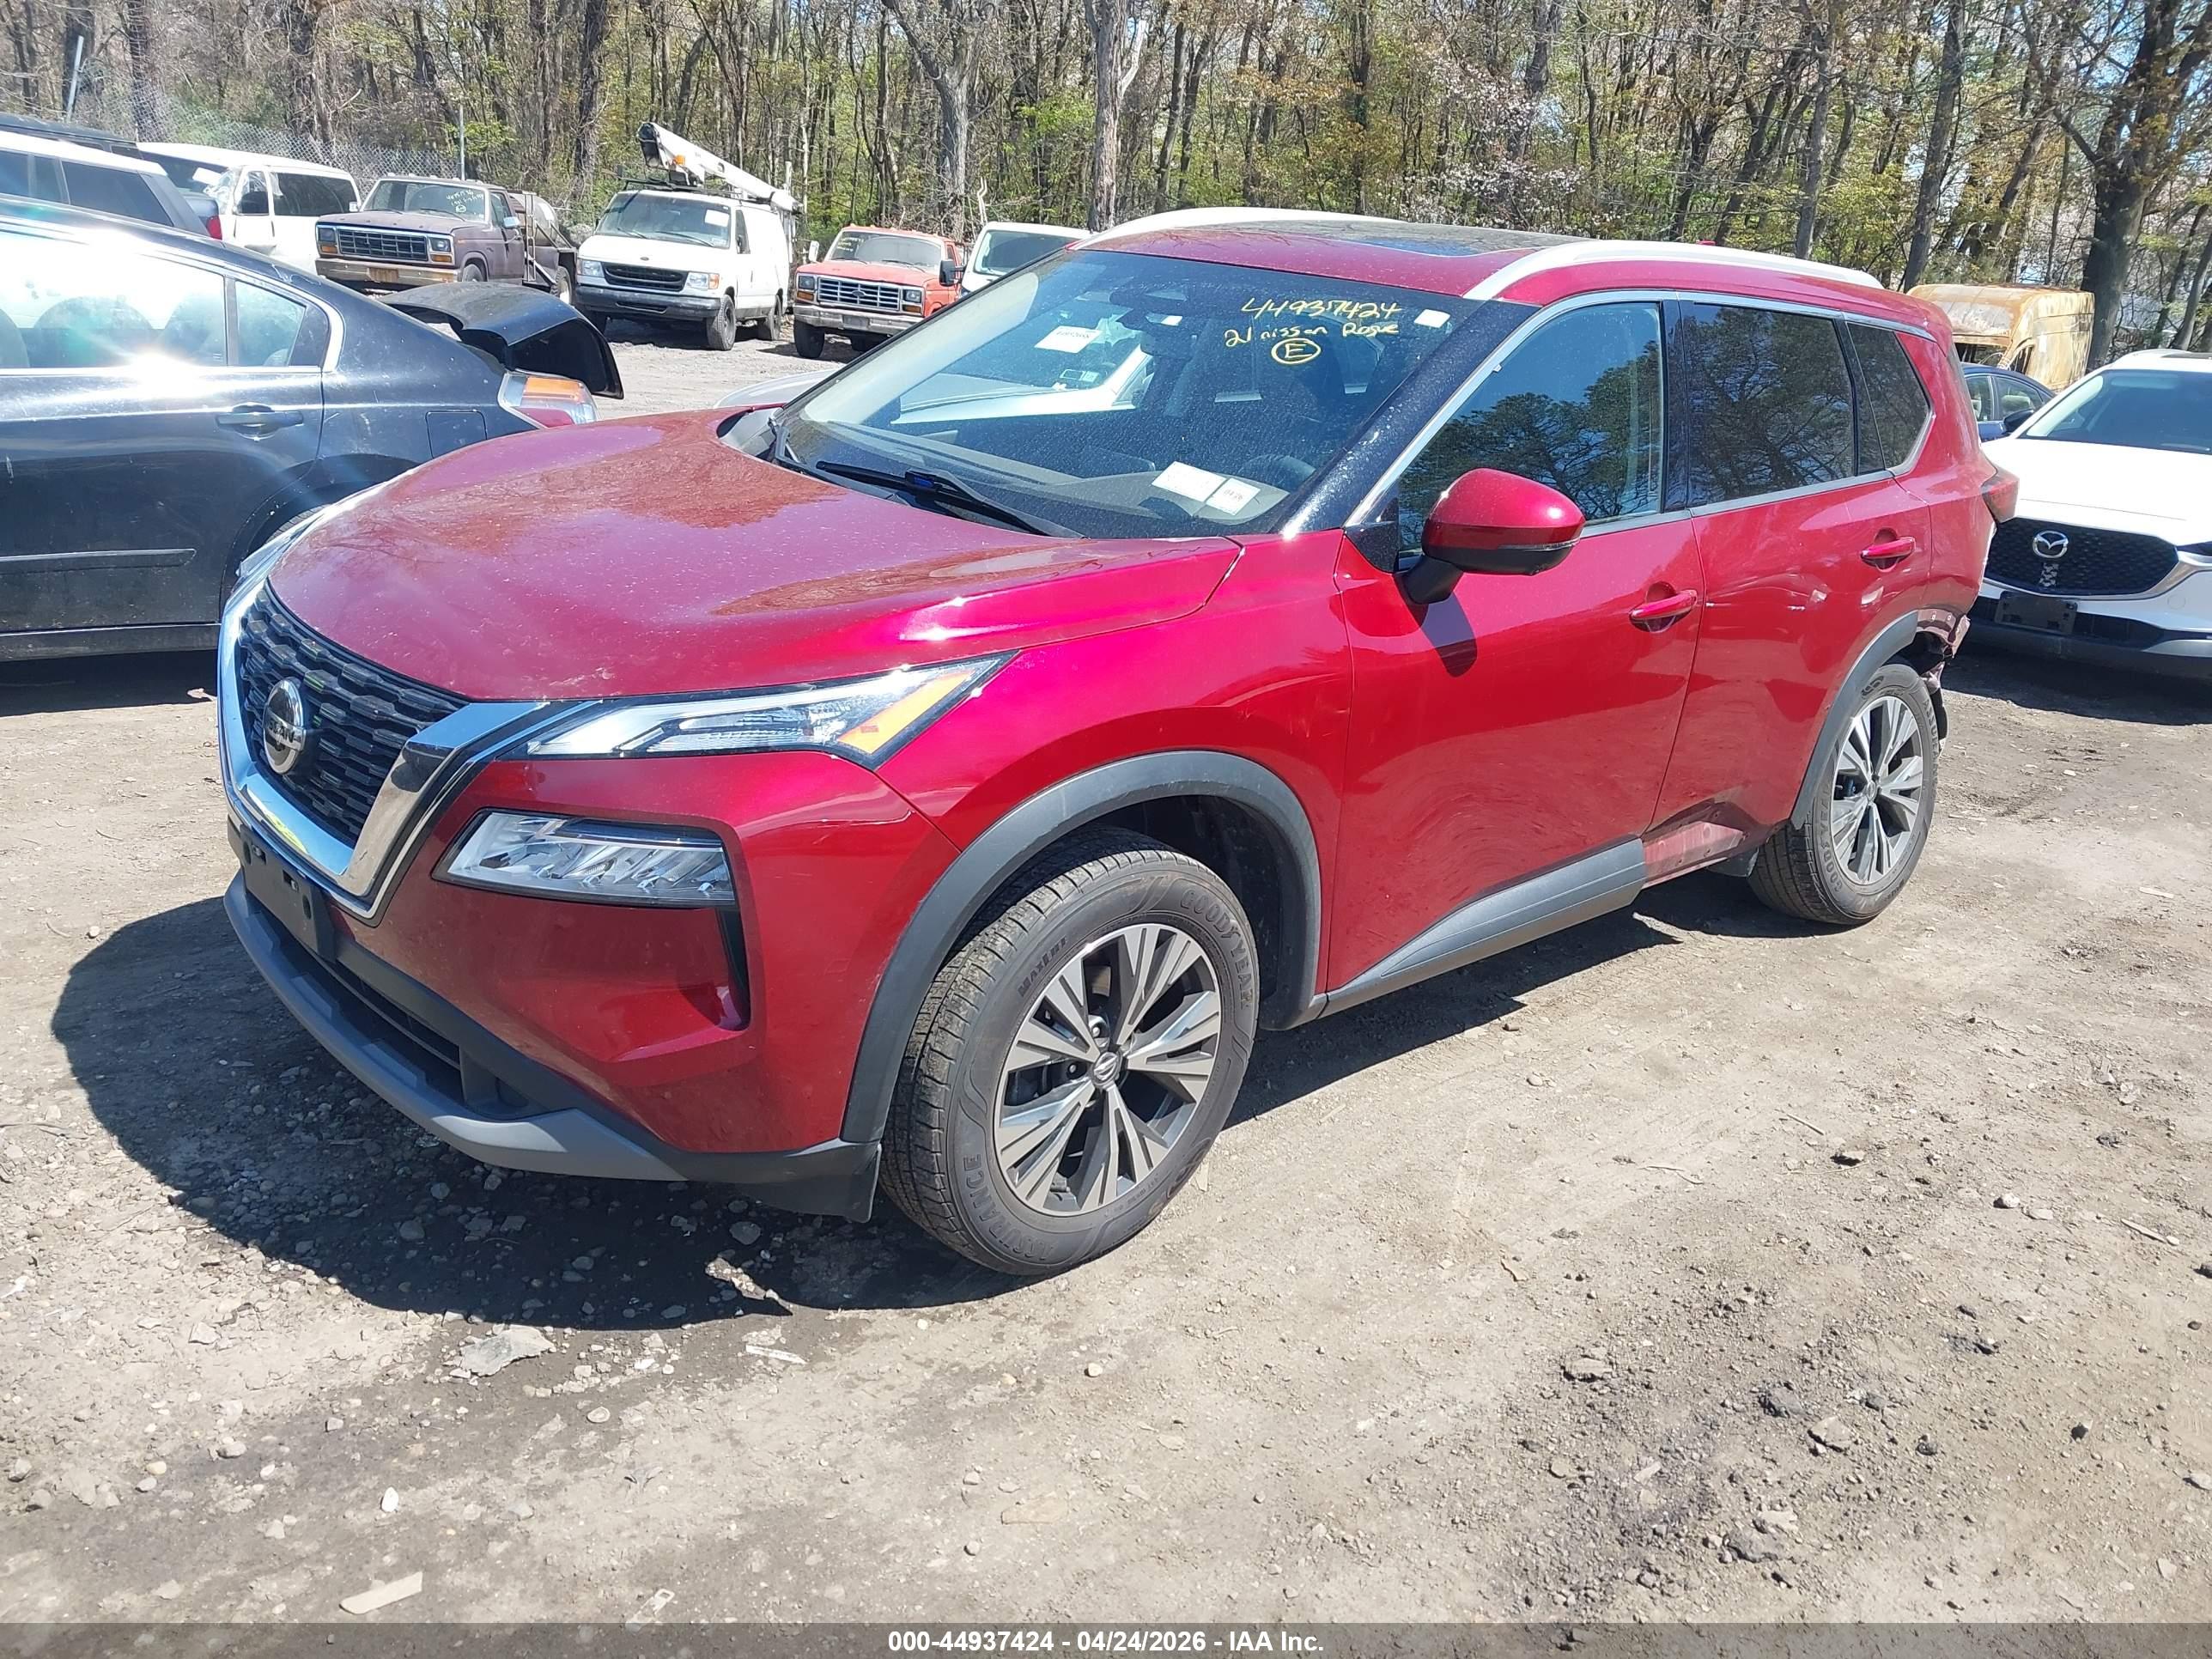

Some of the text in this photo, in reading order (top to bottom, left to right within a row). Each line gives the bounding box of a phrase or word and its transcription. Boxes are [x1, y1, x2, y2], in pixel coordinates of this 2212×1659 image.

[1224, 326, 1252, 347] 21
[1242, 298, 1401, 319] 44937424
[1180, 888, 1254, 1010] GOODYEAR
[963, 1153, 1058, 1261] ASSURANCE
